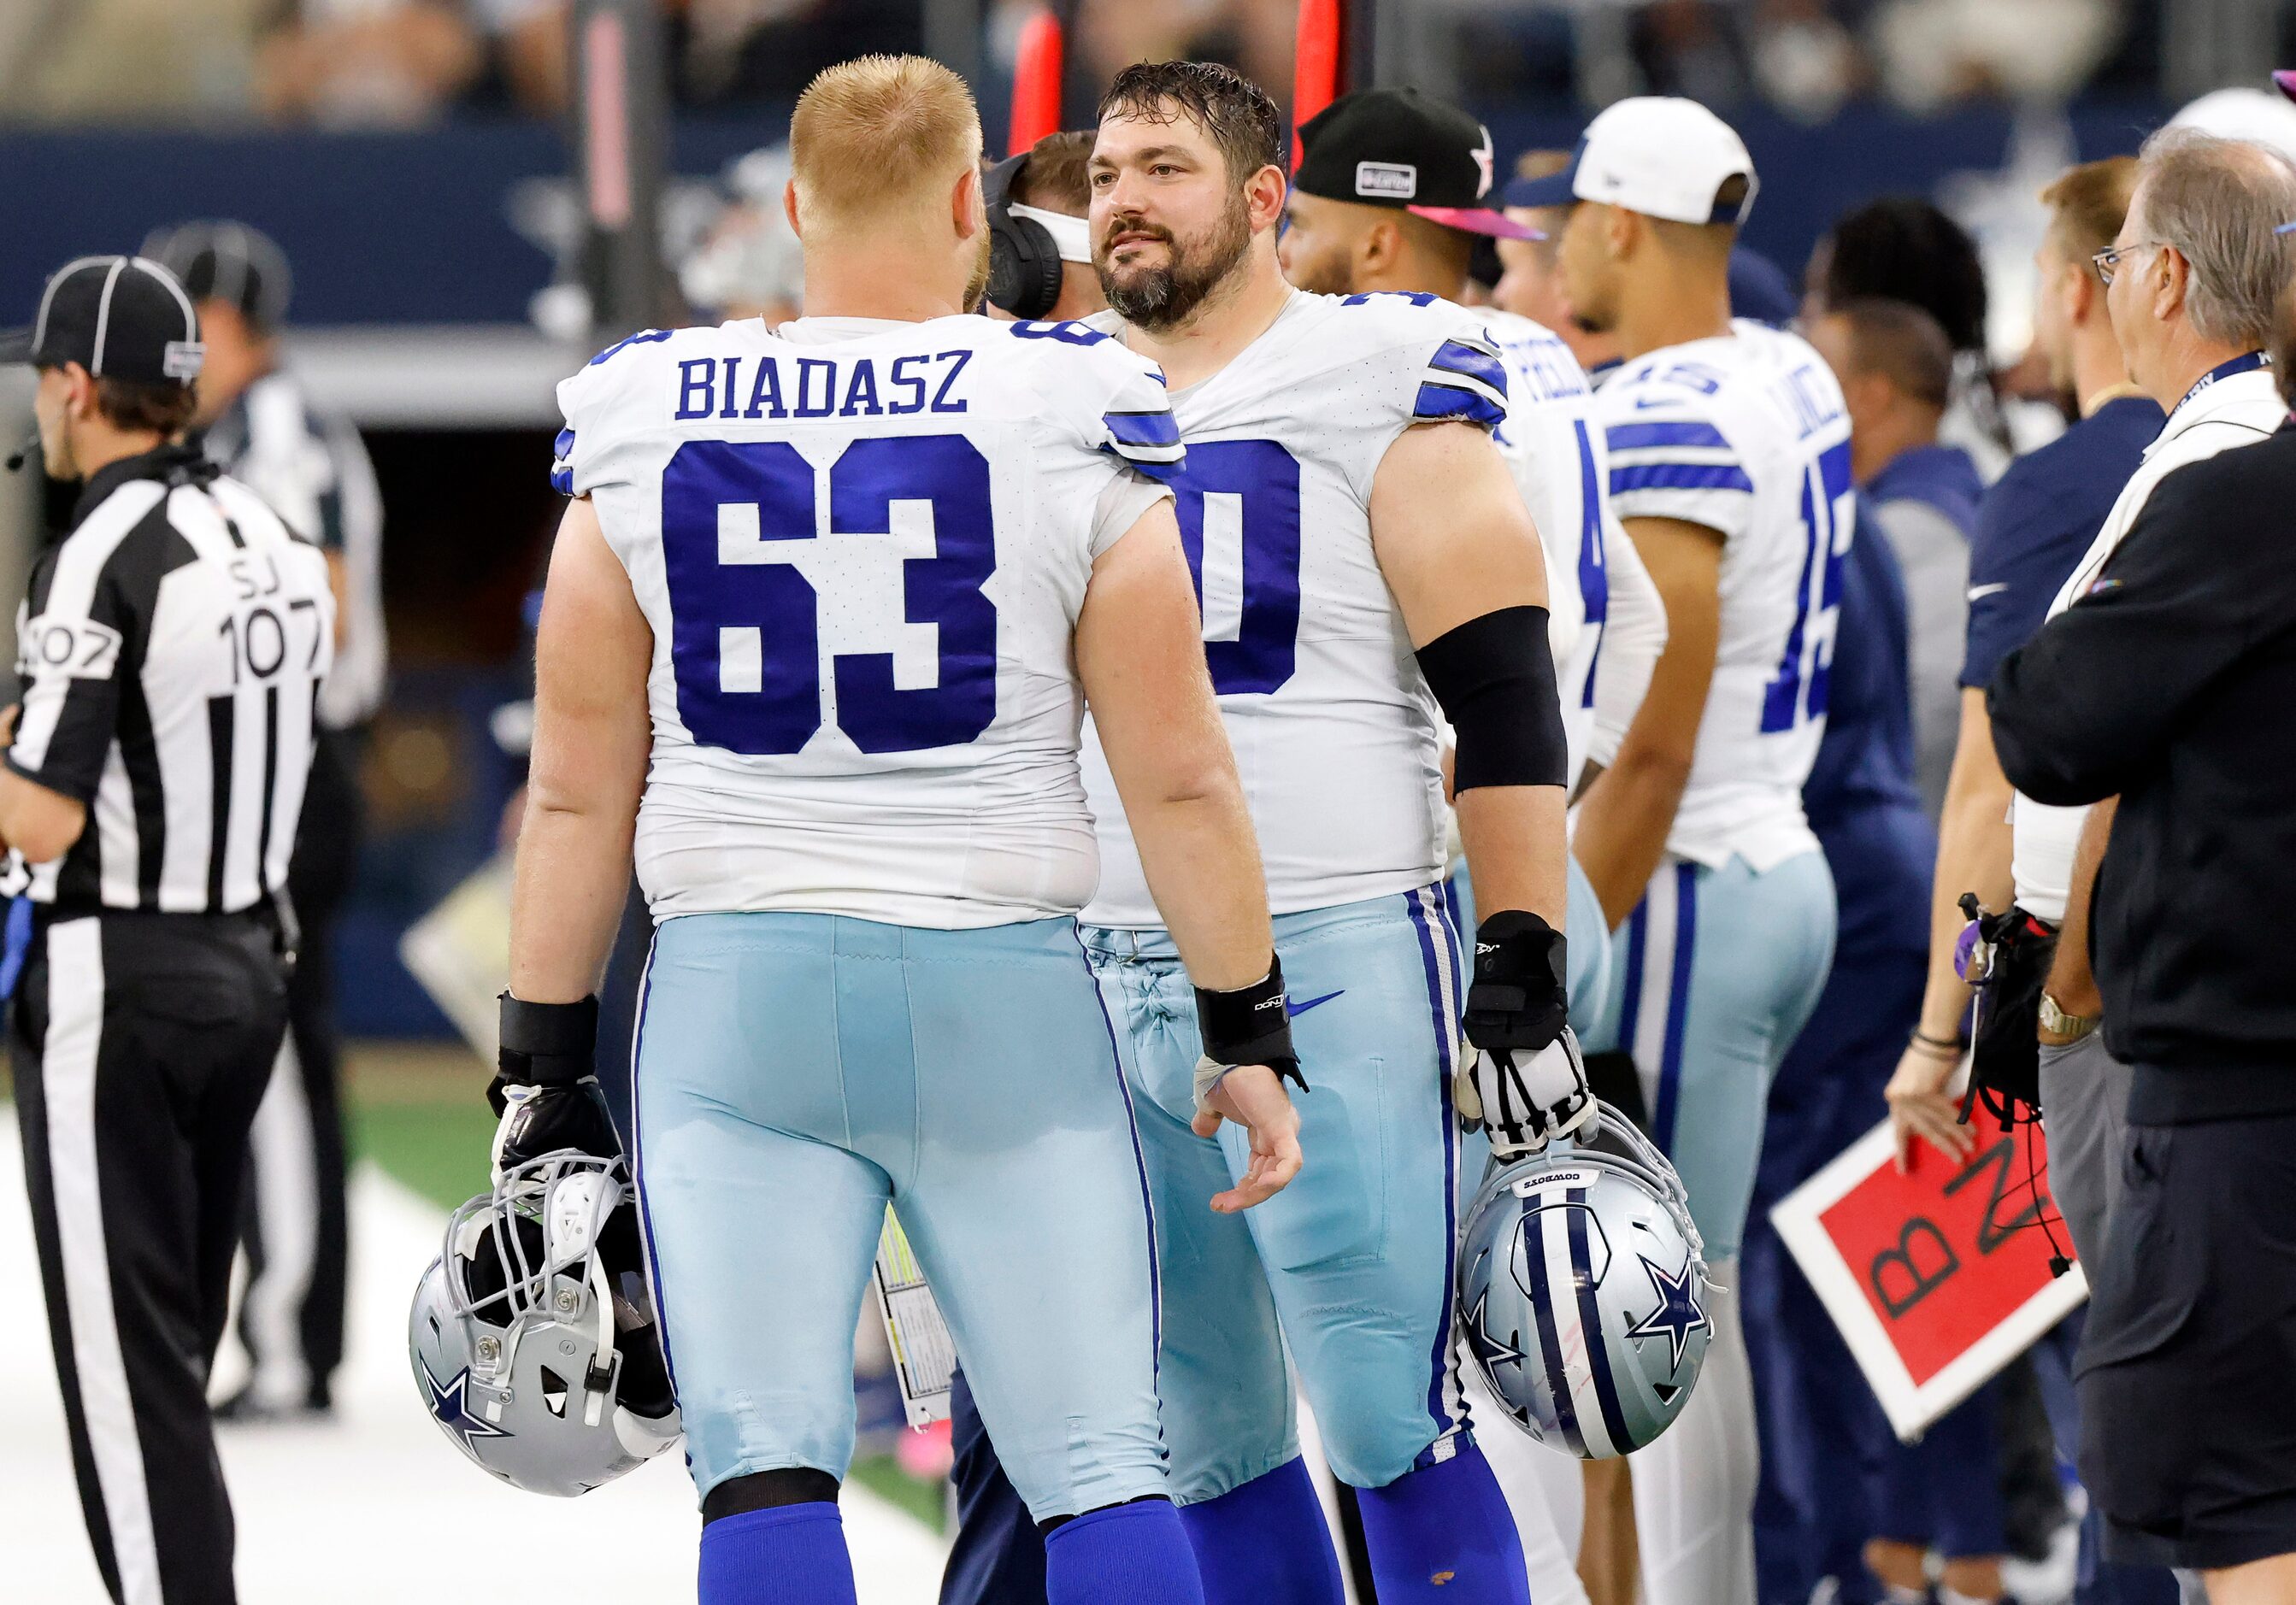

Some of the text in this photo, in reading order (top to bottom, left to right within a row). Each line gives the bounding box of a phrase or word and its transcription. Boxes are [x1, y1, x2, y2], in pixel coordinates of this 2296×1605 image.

[675, 350, 972, 420] BIADASZ
[229, 554, 280, 600] SJ
[662, 433, 997, 755] 63
[1761, 438, 1852, 732] 15
[220, 599, 321, 686] 107
[1524, 1173, 1581, 1189] COWBOYS
